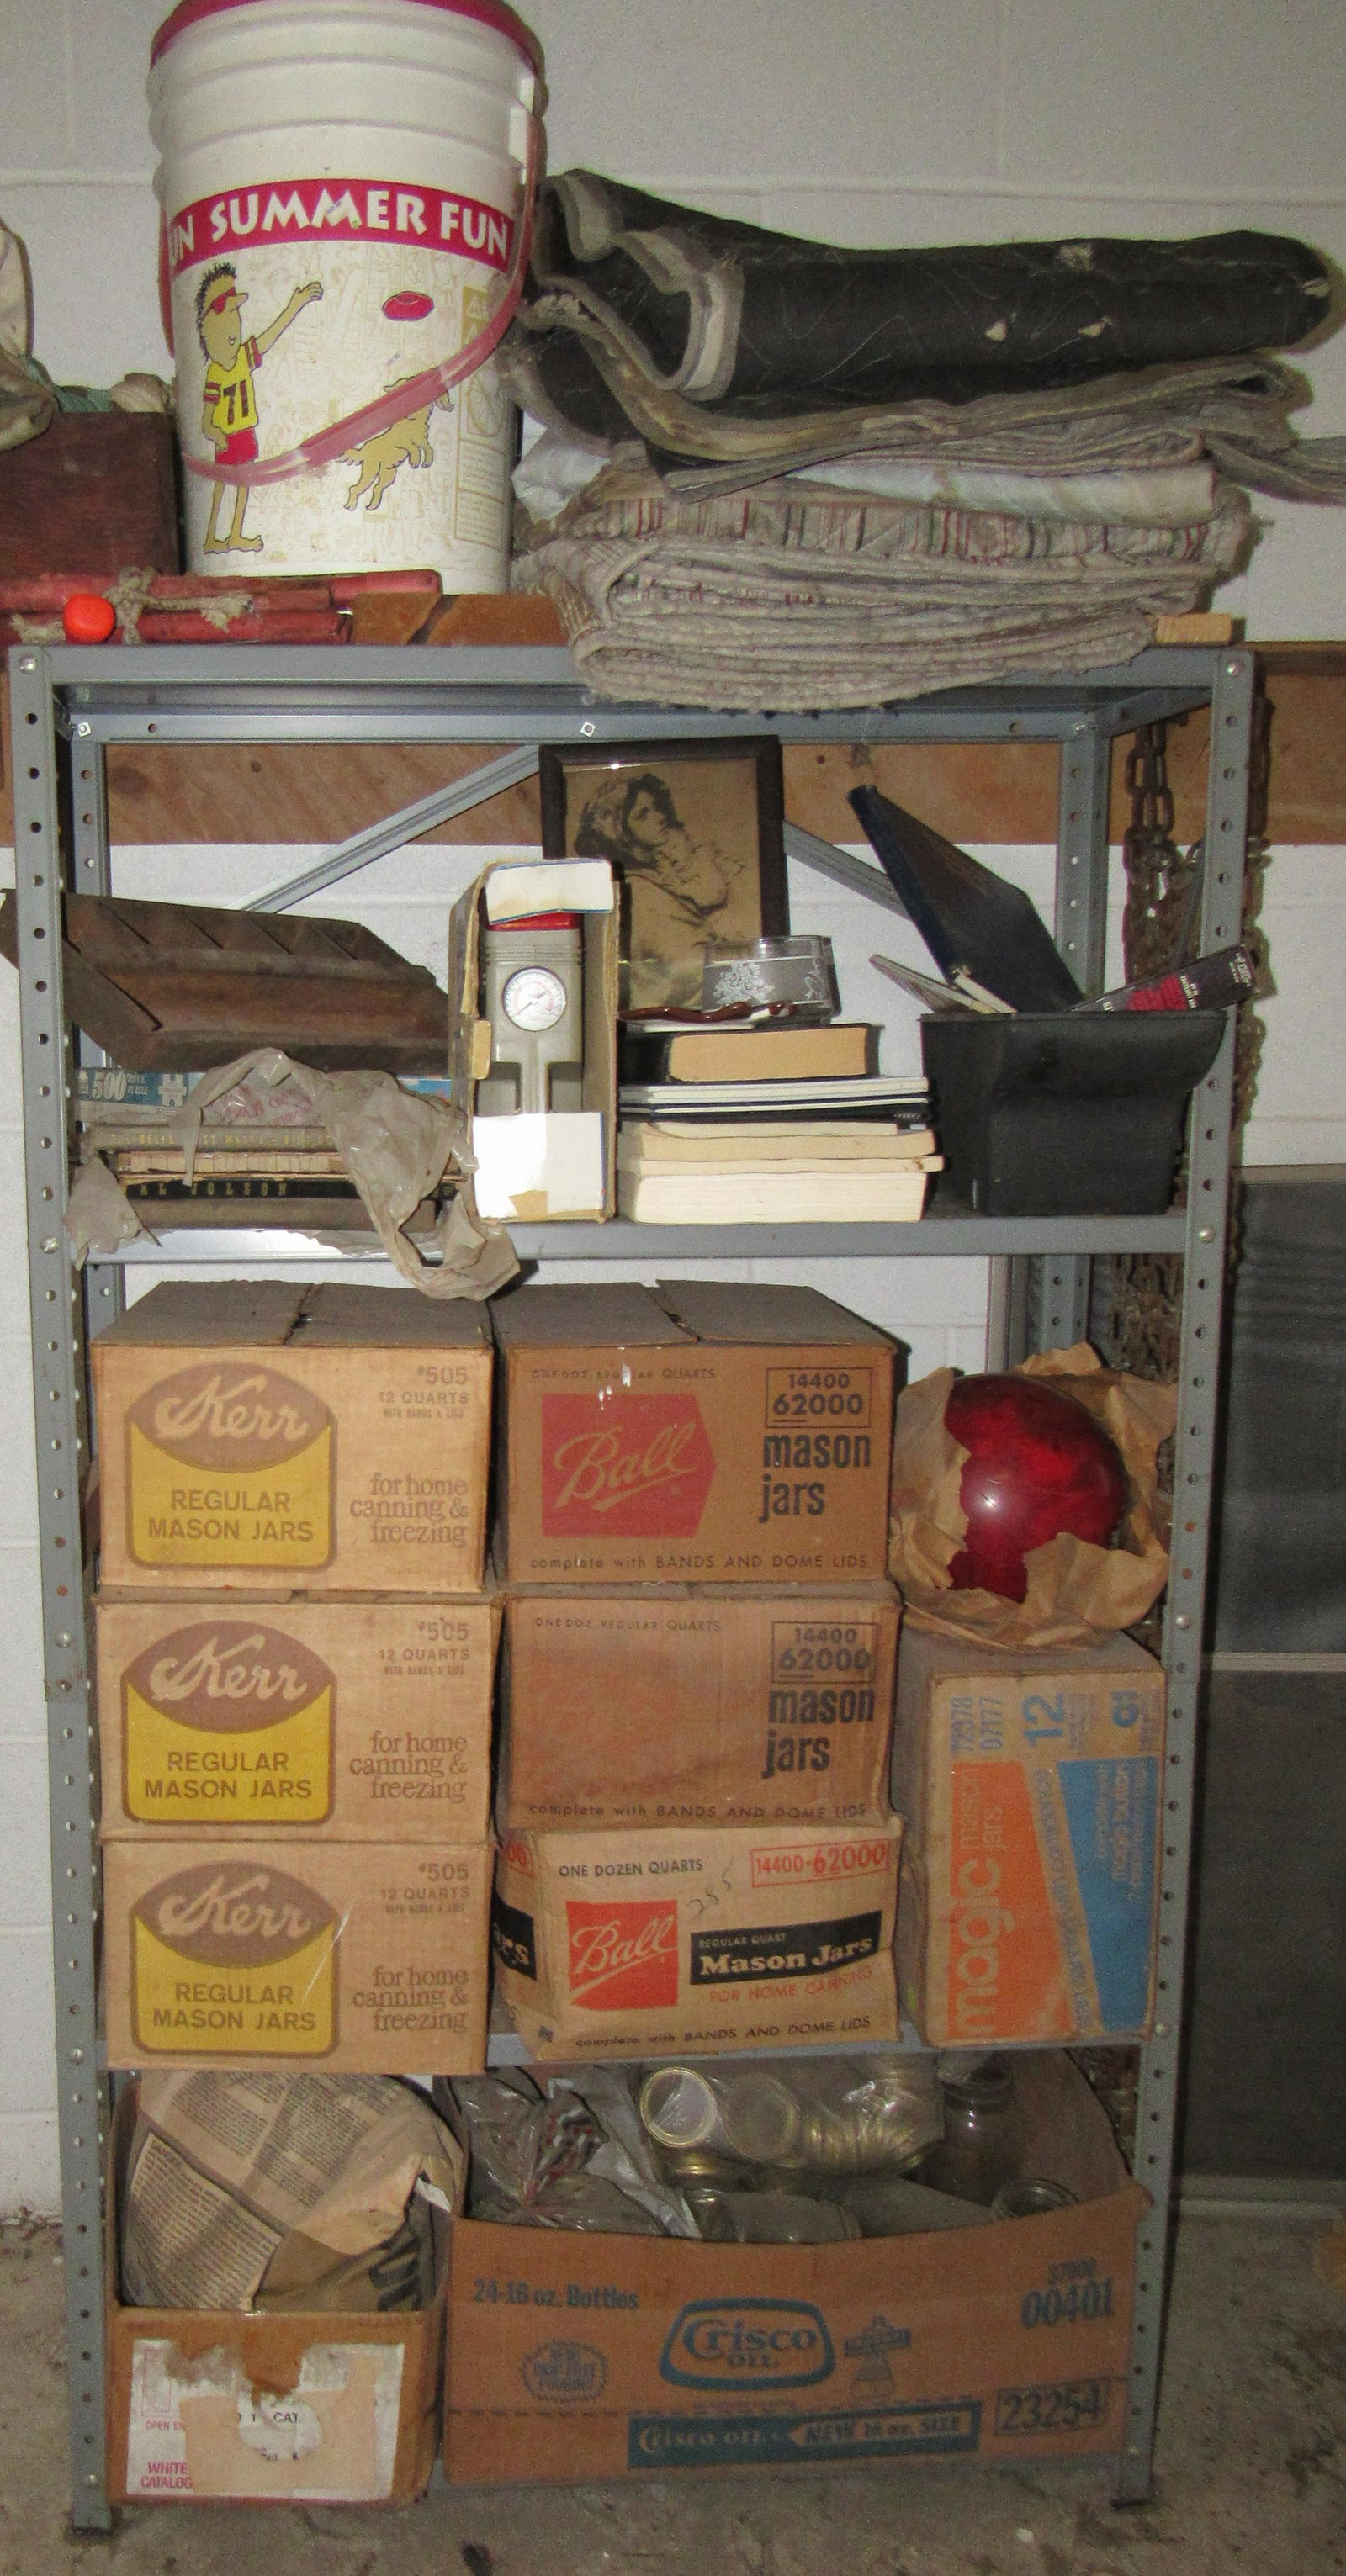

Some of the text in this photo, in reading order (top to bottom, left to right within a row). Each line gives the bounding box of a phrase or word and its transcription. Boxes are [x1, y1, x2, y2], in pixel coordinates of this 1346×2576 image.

[210, 188, 427, 242] SUMMER
[440, 202, 509, 258] FUN
[92, 1071, 126, 1102] 500
[190, 1182, 287, 1196] JOLSON
[661, 1367, 716, 1379] QUARTS
[787, 1373, 851, 1390] 14400
[154, 1375, 310, 1441] Kerr
[378, 1391, 470, 1404] 12 QUARTS
[772, 1392, 864, 1417] 62000
[762, 1432, 872, 1468] mason
[551, 1421, 697, 1510] Ball
[370, 1471, 469, 1497] for home
[170, 1489, 291, 1514] REGULAR
[349, 1496, 469, 1523] canning &
[758, 1473, 826, 1524] jars
[146, 1517, 315, 1542] MASON JARS
[370, 1519, 467, 1549] freezing
[530, 1554, 869, 1570] complete with BANDS AND DOME LIDS
[534, 1616, 721, 1632] ONE DOZ REGULAR QUARTS
[793, 1627, 857, 1645] 14400
[378, 1648, 470, 1661] 12 QUARTS
[778, 1647, 872, 1672] 62000
[149, 1634, 309, 1701] Kerr
[767, 1687, 877, 1724] mason
[1020, 1691, 1066, 1748] 12
[370, 1730, 468, 1754] for home
[761, 1728, 831, 1780] jars
[167, 1750, 289, 1773] REGULAR
[349, 1752, 469, 1780] canning &
[144, 1779, 312, 1800] MASON JARS
[370, 1776, 468, 1803] freezing
[529, 1803, 606, 1818] complete
[613, 1803, 648, 1817] with
[655, 1804, 716, 1818] BANDS
[726, 1805, 765, 1819] AND
[773, 1806, 826, 1820] DOME
[559, 1858, 703, 1878] ONE DOZEN QUARTS
[755, 1840, 888, 1877] 14400-62000
[380, 1886, 471, 1901] 12 QUARTS
[157, 1874, 312, 1939] Kerr
[570, 1914, 679, 1976] Ball
[698, 1932, 787, 1948] REGULAR QUART
[956, 1859, 1015, 2037] magic
[699, 1936, 874, 1976] Mason Jars
[372, 1965, 469, 1988] for home
[709, 1965, 873, 2003] FOR HOME CANNING
[174, 1981, 294, 2006] REGULAR
[351, 1986, 469, 2008] canning &
[152, 2007, 318, 2032] MASON JARS
[372, 2009, 469, 2034] freezing
[575, 2015, 872, 2049] complete with BANDS AND DOME LIDS
[566, 2283, 639, 2309] Bottles
[1020, 2277, 1114, 2329] 00401
[682, 2319, 817, 2362] Crisco
[725, 2353, 780, 2369] OIL
[144, 2420, 170, 2431] OPEN
[638, 2426, 715, 2454] Crisco
[147, 2462, 188, 2475] WHITE
[140, 2475, 193, 2489] CATALOG
